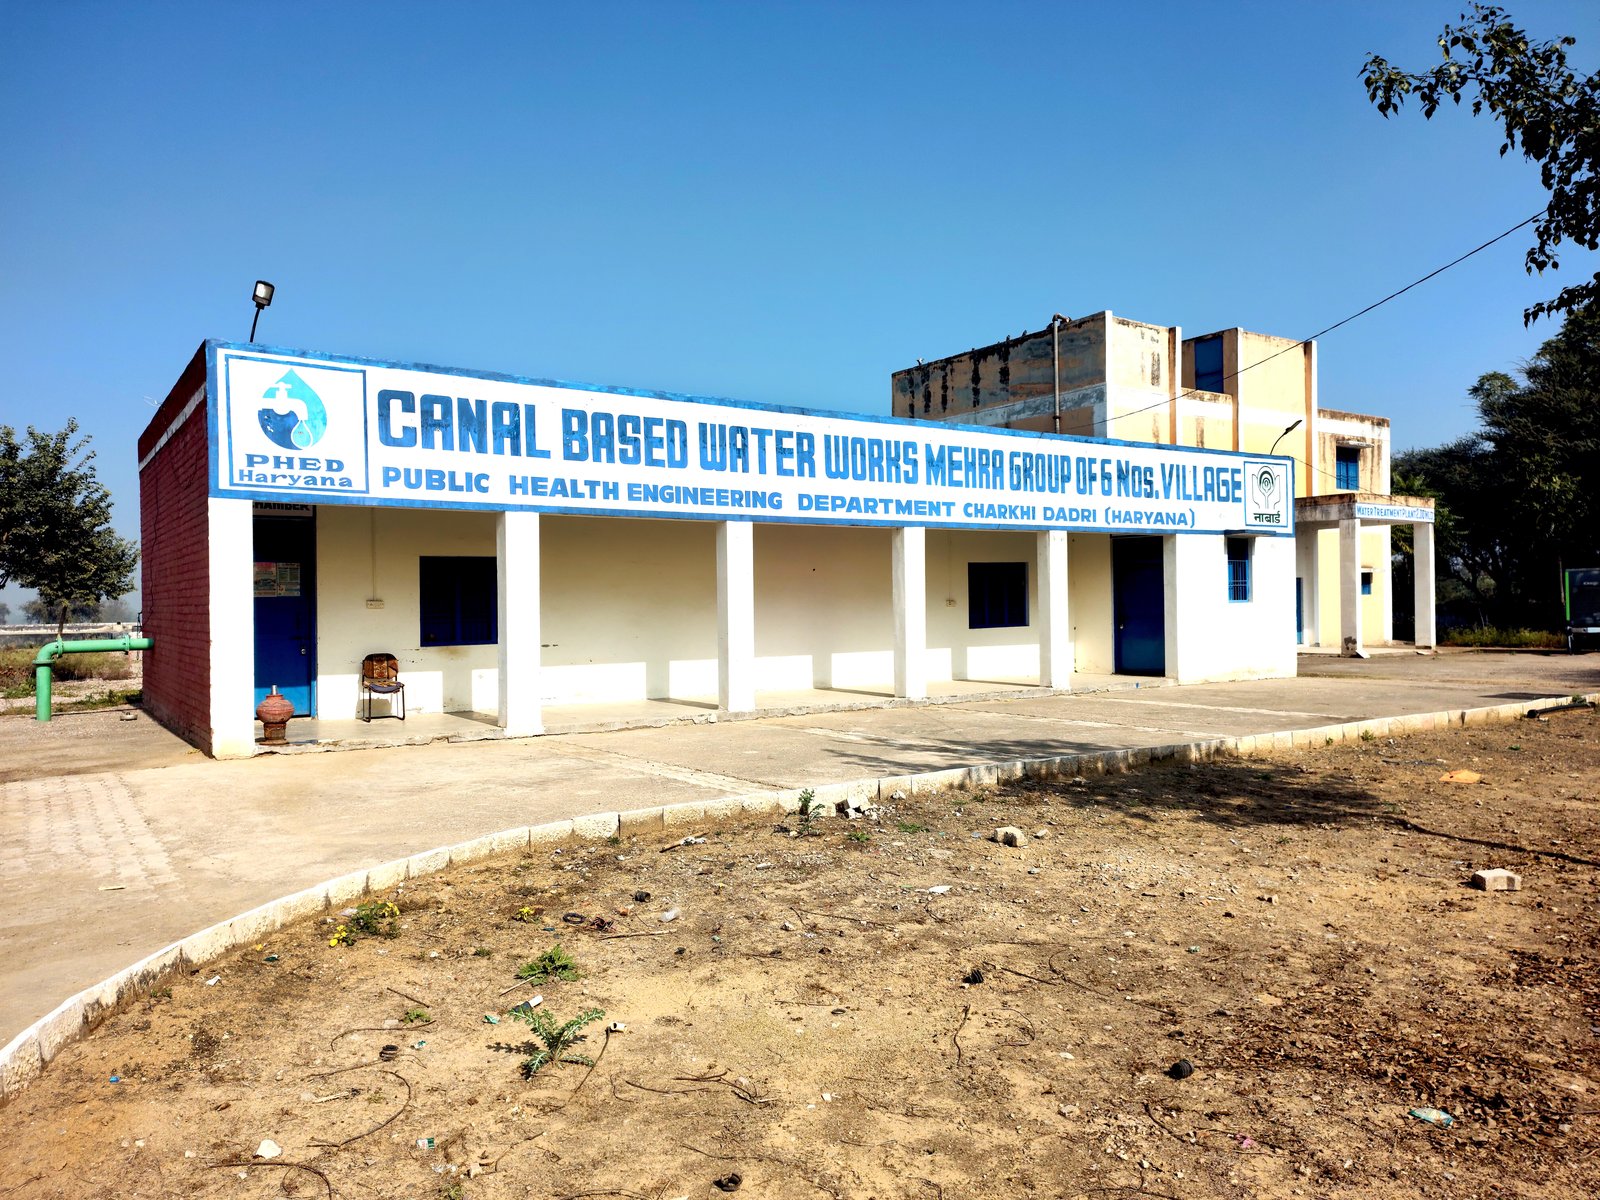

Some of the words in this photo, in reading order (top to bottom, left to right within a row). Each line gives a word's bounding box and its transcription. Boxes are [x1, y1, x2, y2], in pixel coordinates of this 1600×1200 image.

[377, 388, 552, 459] CANAL
[561, 408, 689, 469] BASED
[698, 421, 816, 479] WATER
[823, 433, 919, 485] WORKS
[925, 443, 1005, 491] MEHRA
[1009, 450, 1072, 494] GROUP
[1075, 456, 1098, 496] OF
[1100, 458, 1113, 497] 6
[1160, 462, 1243, 503] VILLAGE
[245, 453, 345, 473] PHED
[238, 468, 353, 488] Haryana
[252, 501, 311, 511] HAMBER
[382, 466, 490, 494] PUBLIC
[509, 474, 619, 501] HEALTH
[627, 483, 783, 511] ENGINEERING
[798, 493, 956, 517] DEPARTMENT
[963, 502, 1036, 521] CHARKHI
[1042, 506, 1097, 523] DADRI
[1104, 506, 1195, 529] (HARYANA)
[1253, 510, 1282, 524] नाबार्ड
